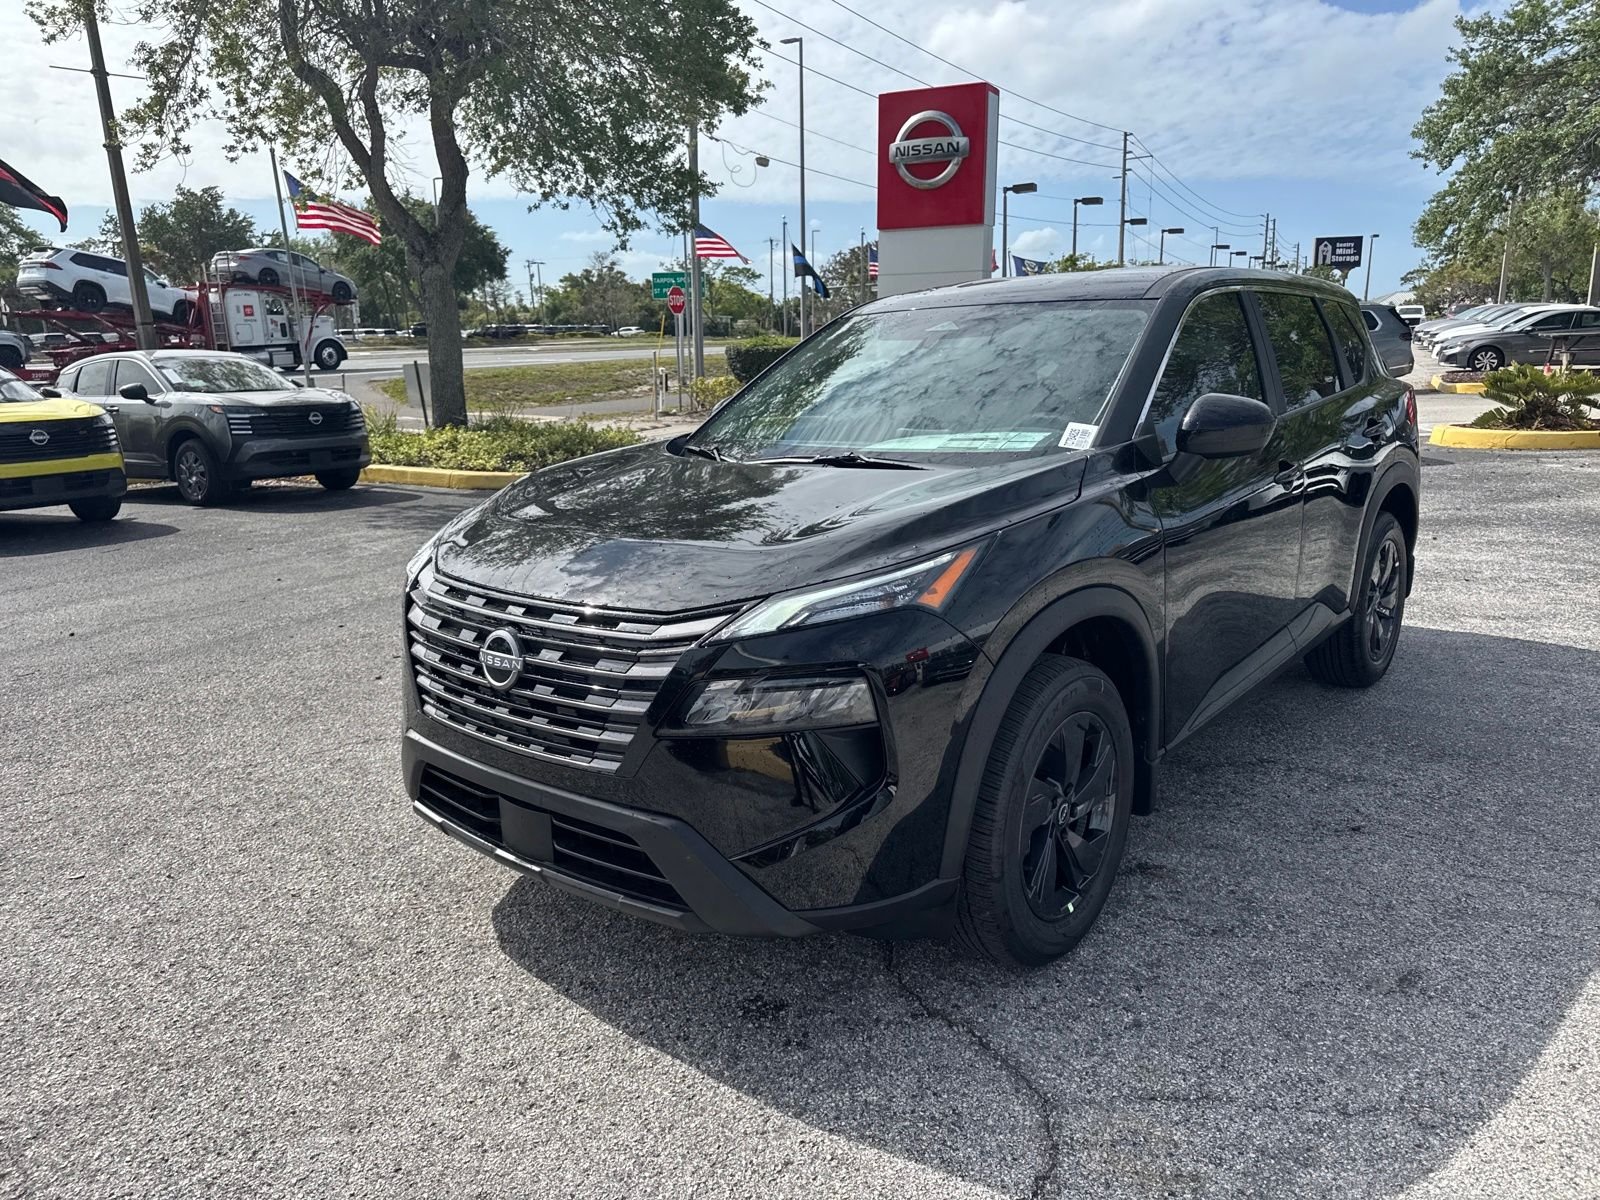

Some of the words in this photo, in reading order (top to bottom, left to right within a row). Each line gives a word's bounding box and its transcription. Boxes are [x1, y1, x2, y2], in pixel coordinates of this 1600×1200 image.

[895, 141, 960, 158] NISSAN
[1331, 255, 1360, 263] Storage
[669, 295, 685, 306] STOP
[480, 651, 521, 670] NISSAN
